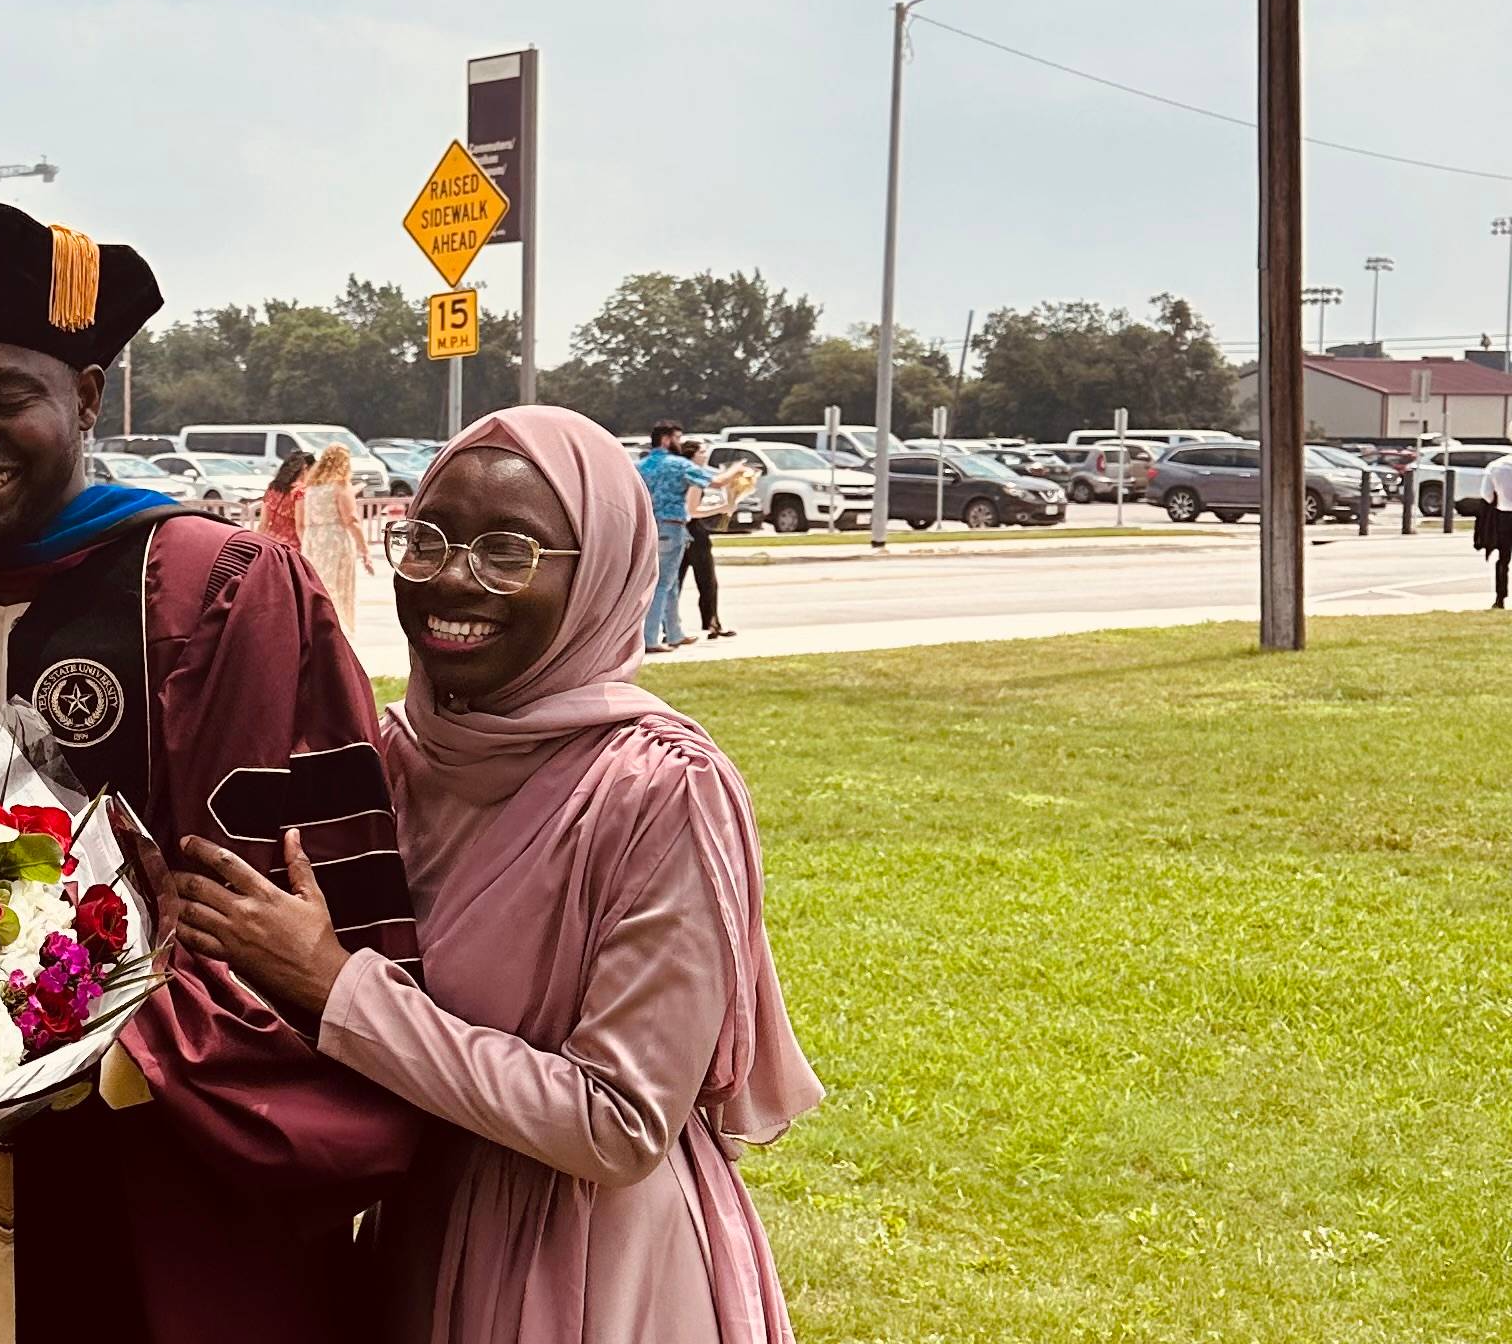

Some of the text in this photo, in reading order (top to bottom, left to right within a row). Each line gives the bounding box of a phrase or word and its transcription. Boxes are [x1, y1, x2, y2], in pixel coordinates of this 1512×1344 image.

[430, 174, 479, 200] RAISED
[421, 200, 488, 229] SIDEWALK
[431, 230, 476, 255] AHEAD
[438, 298, 468, 332] 15
[38, 663, 119, 711] TEXAS STATE UNIVERSITY
